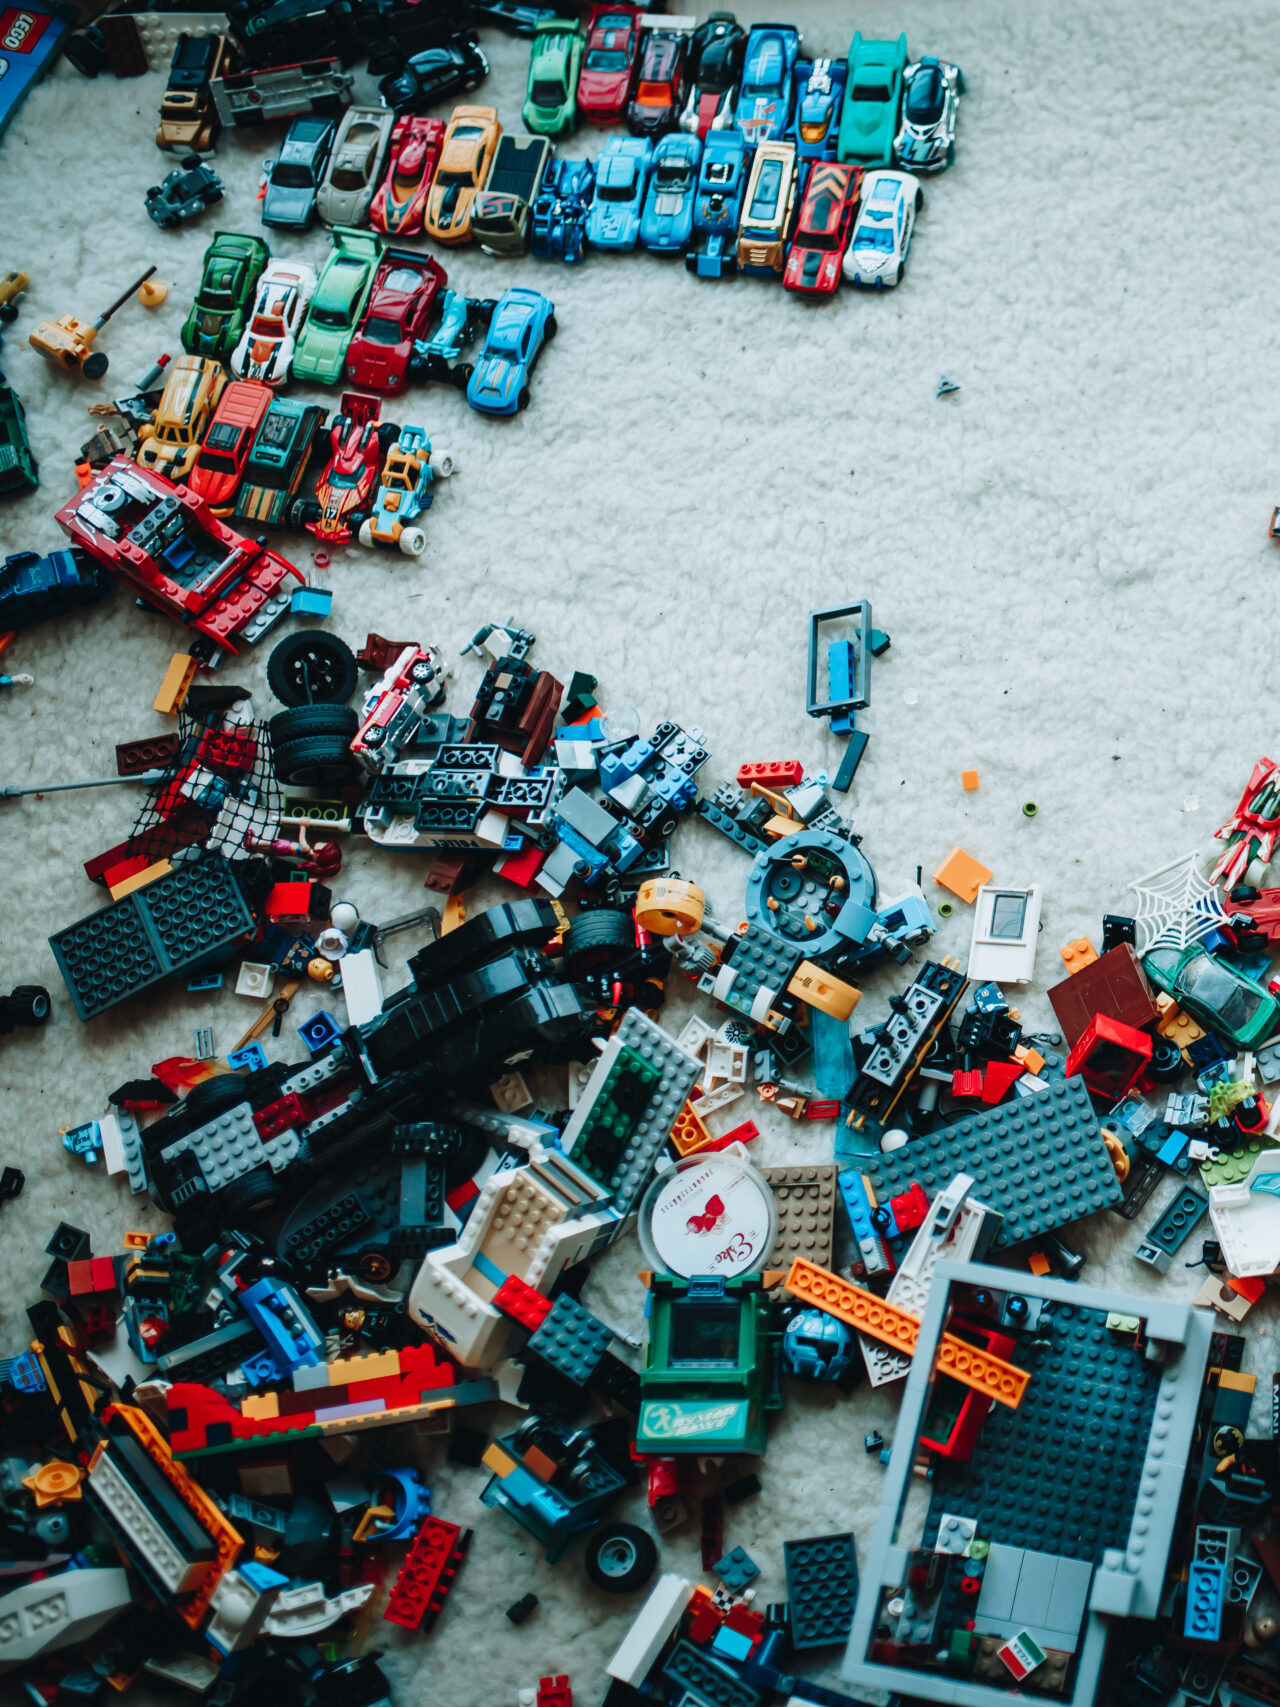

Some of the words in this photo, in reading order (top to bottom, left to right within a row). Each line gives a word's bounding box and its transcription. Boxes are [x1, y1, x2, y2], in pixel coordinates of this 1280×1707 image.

[1, 11, 36, 50] LEGO
[326, 507, 338, 519] 17
[430, 840, 480, 850] POLICE
[713, 1232, 753, 1264] Esko
[1272, 1383, 1280, 1435] MINI
[1012, 1642, 1032, 1668] PIZZA
